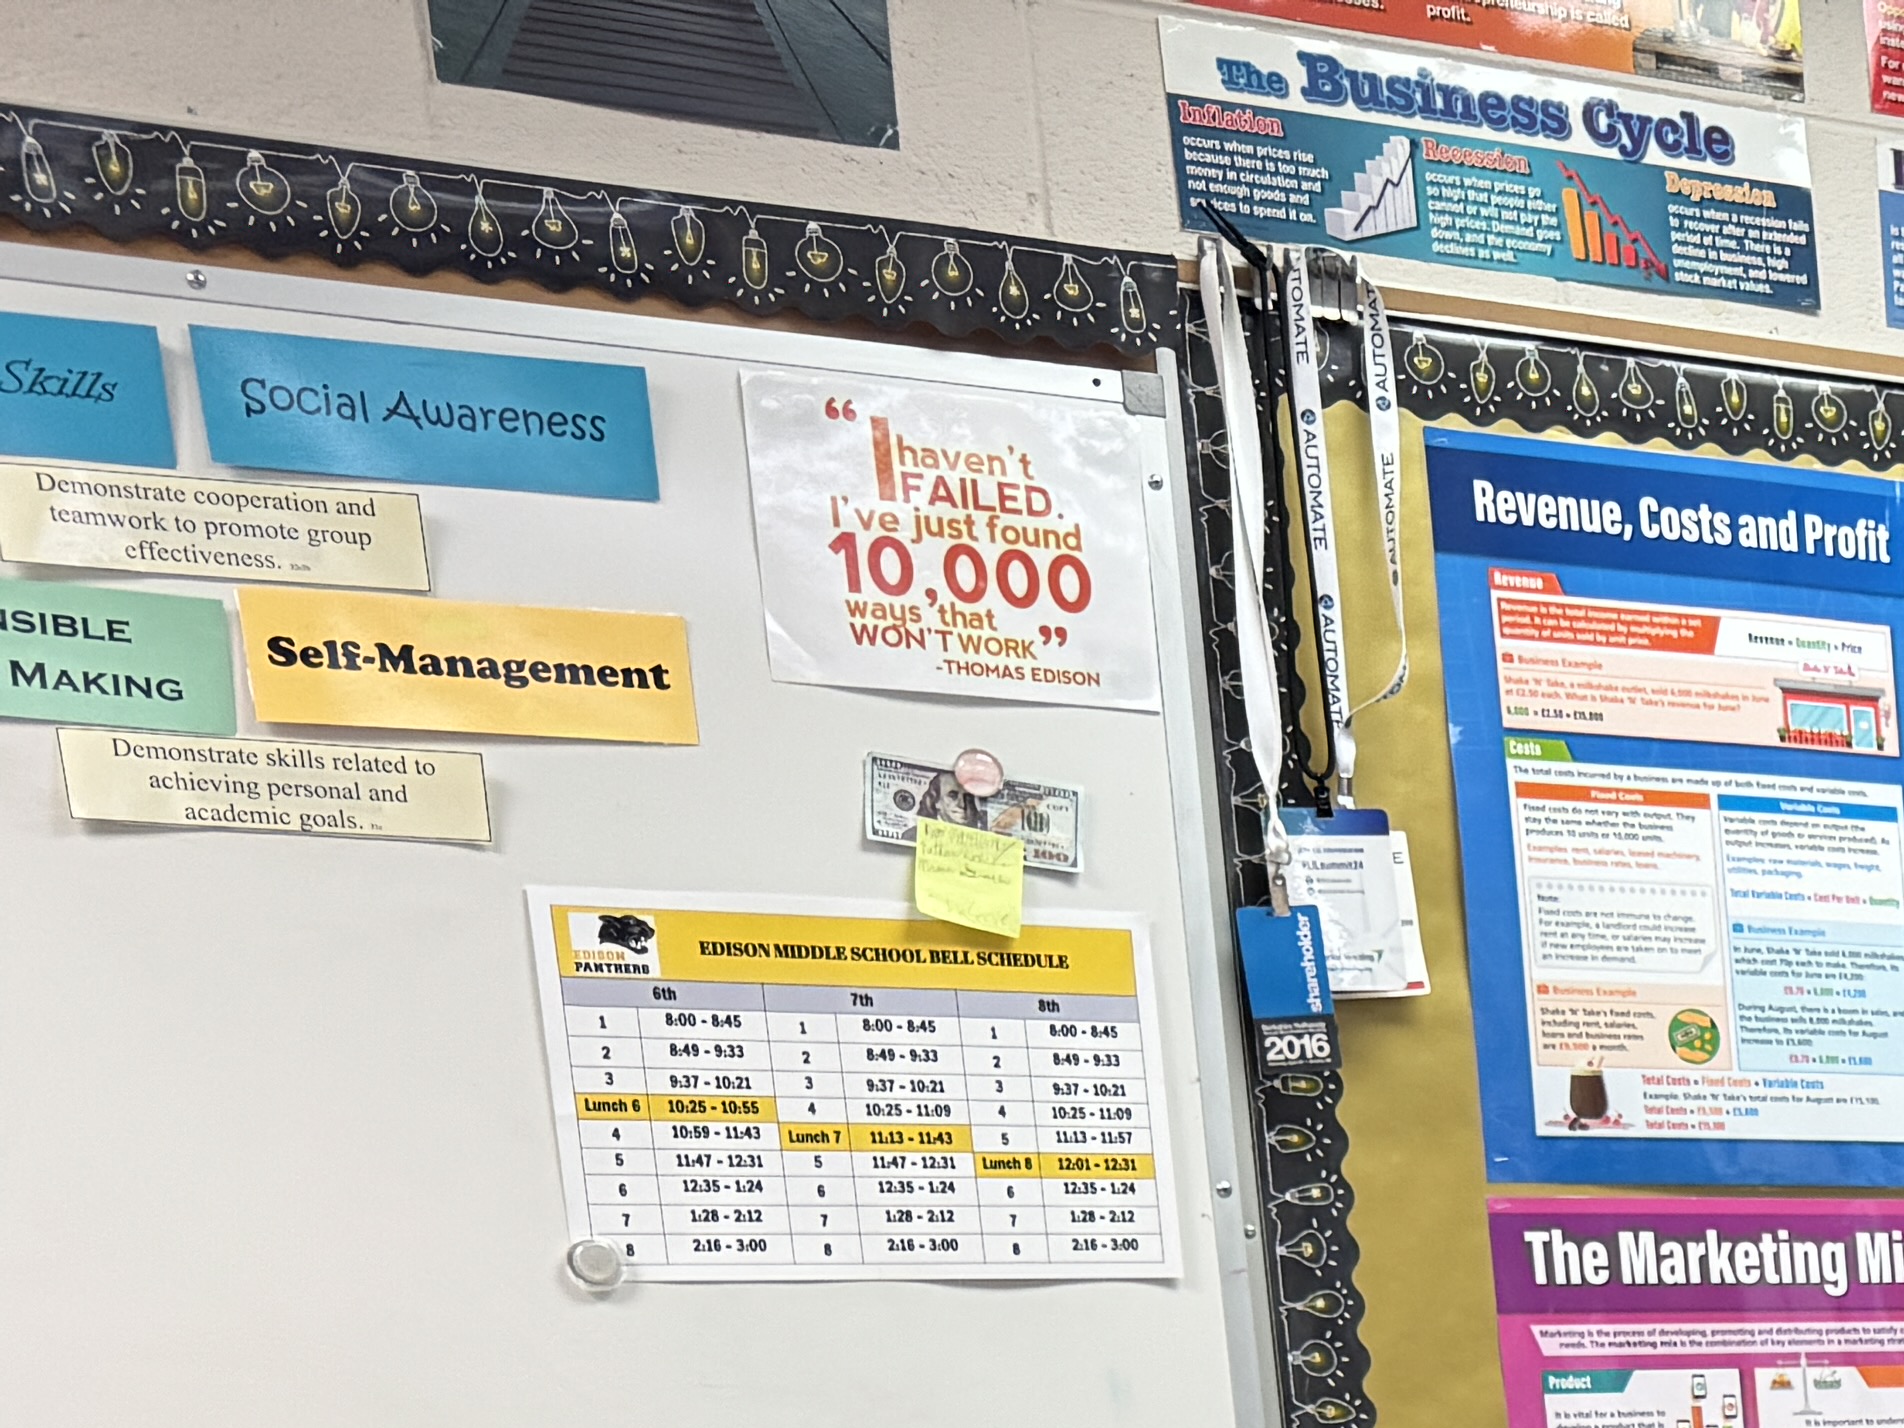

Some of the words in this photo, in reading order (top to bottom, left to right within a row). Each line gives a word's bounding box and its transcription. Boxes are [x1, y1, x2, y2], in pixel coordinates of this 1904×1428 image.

[1178, 99, 1284, 138] Inflation
[1216, 54, 1290, 100] The
[1297, 49, 1573, 141] Business
[1581, 97, 1735, 165] Cycle
[1421, 137, 1530, 175] Recession
[1664, 171, 1777, 209] Depression
[0, 358, 118, 404] Skills
[241, 378, 370, 424] Social
[383, 390, 606, 444] Awareness
[896, 434, 1035, 481] haven't
[35, 471, 186, 505] Demonstrate
[194, 487, 328, 519] cooperation
[335, 497, 376, 519] and
[900, 472, 1064, 519] FAILED.
[1302, 429, 1327, 551] AUTOMATE
[49, 504, 167, 534] teamwork
[174, 513, 197, 534] to
[203, 518, 299, 547] promote
[306, 524, 372, 550] group
[830, 495, 900, 533] I've
[911, 507, 979, 544] just
[986, 514, 1082, 552] found
[1381, 452, 1396, 578] AUTOMATE
[1472, 478, 1635, 542] Revenue,
[1638, 495, 1732, 547] Costs
[1737, 508, 1798, 554] and
[1804, 512, 1891, 565] Profit
[125, 540, 282, 572] effectiveness.
[828, 531, 1092, 614] 10,000
[845, 599, 922, 627] ways
[938, 602, 997, 632] that
[849, 623, 954, 650] WON'T
[267, 635, 670, 692] Self-Management
[1032, 667, 1100, 687] EDISON
[112, 736, 259, 767] Demonstrate
[265, 746, 325, 771] skills
[332, 752, 408, 775] related
[414, 758, 435, 777] to
[149, 770, 260, 802] achieving
[267, 777, 361, 805] personal
[368, 783, 407, 804] and
[184, 801, 291, 828] academic
[298, 808, 363, 833] goals.
[1032, 850, 1069, 863] 100
[574, 961, 650, 975] PANTHERS
[698, 940, 771, 959] EDISON
[773, 944, 847, 962] MIDDLE
[850, 947, 926, 965] SCHOOL
[928, 950, 974, 967] BELL
[976, 952, 1070, 970] SCHEDULE
[1296, 913, 1323, 1014] shareholder
[653, 986, 677, 1002] 6th
[850, 992, 873, 1008] 7th
[1038, 998, 1060, 1014] 8th
[1264, 1033, 1331, 1061] 2016
[1522, 1228, 1611, 1286] The
[1617, 1228, 1850, 1298] Marketing
